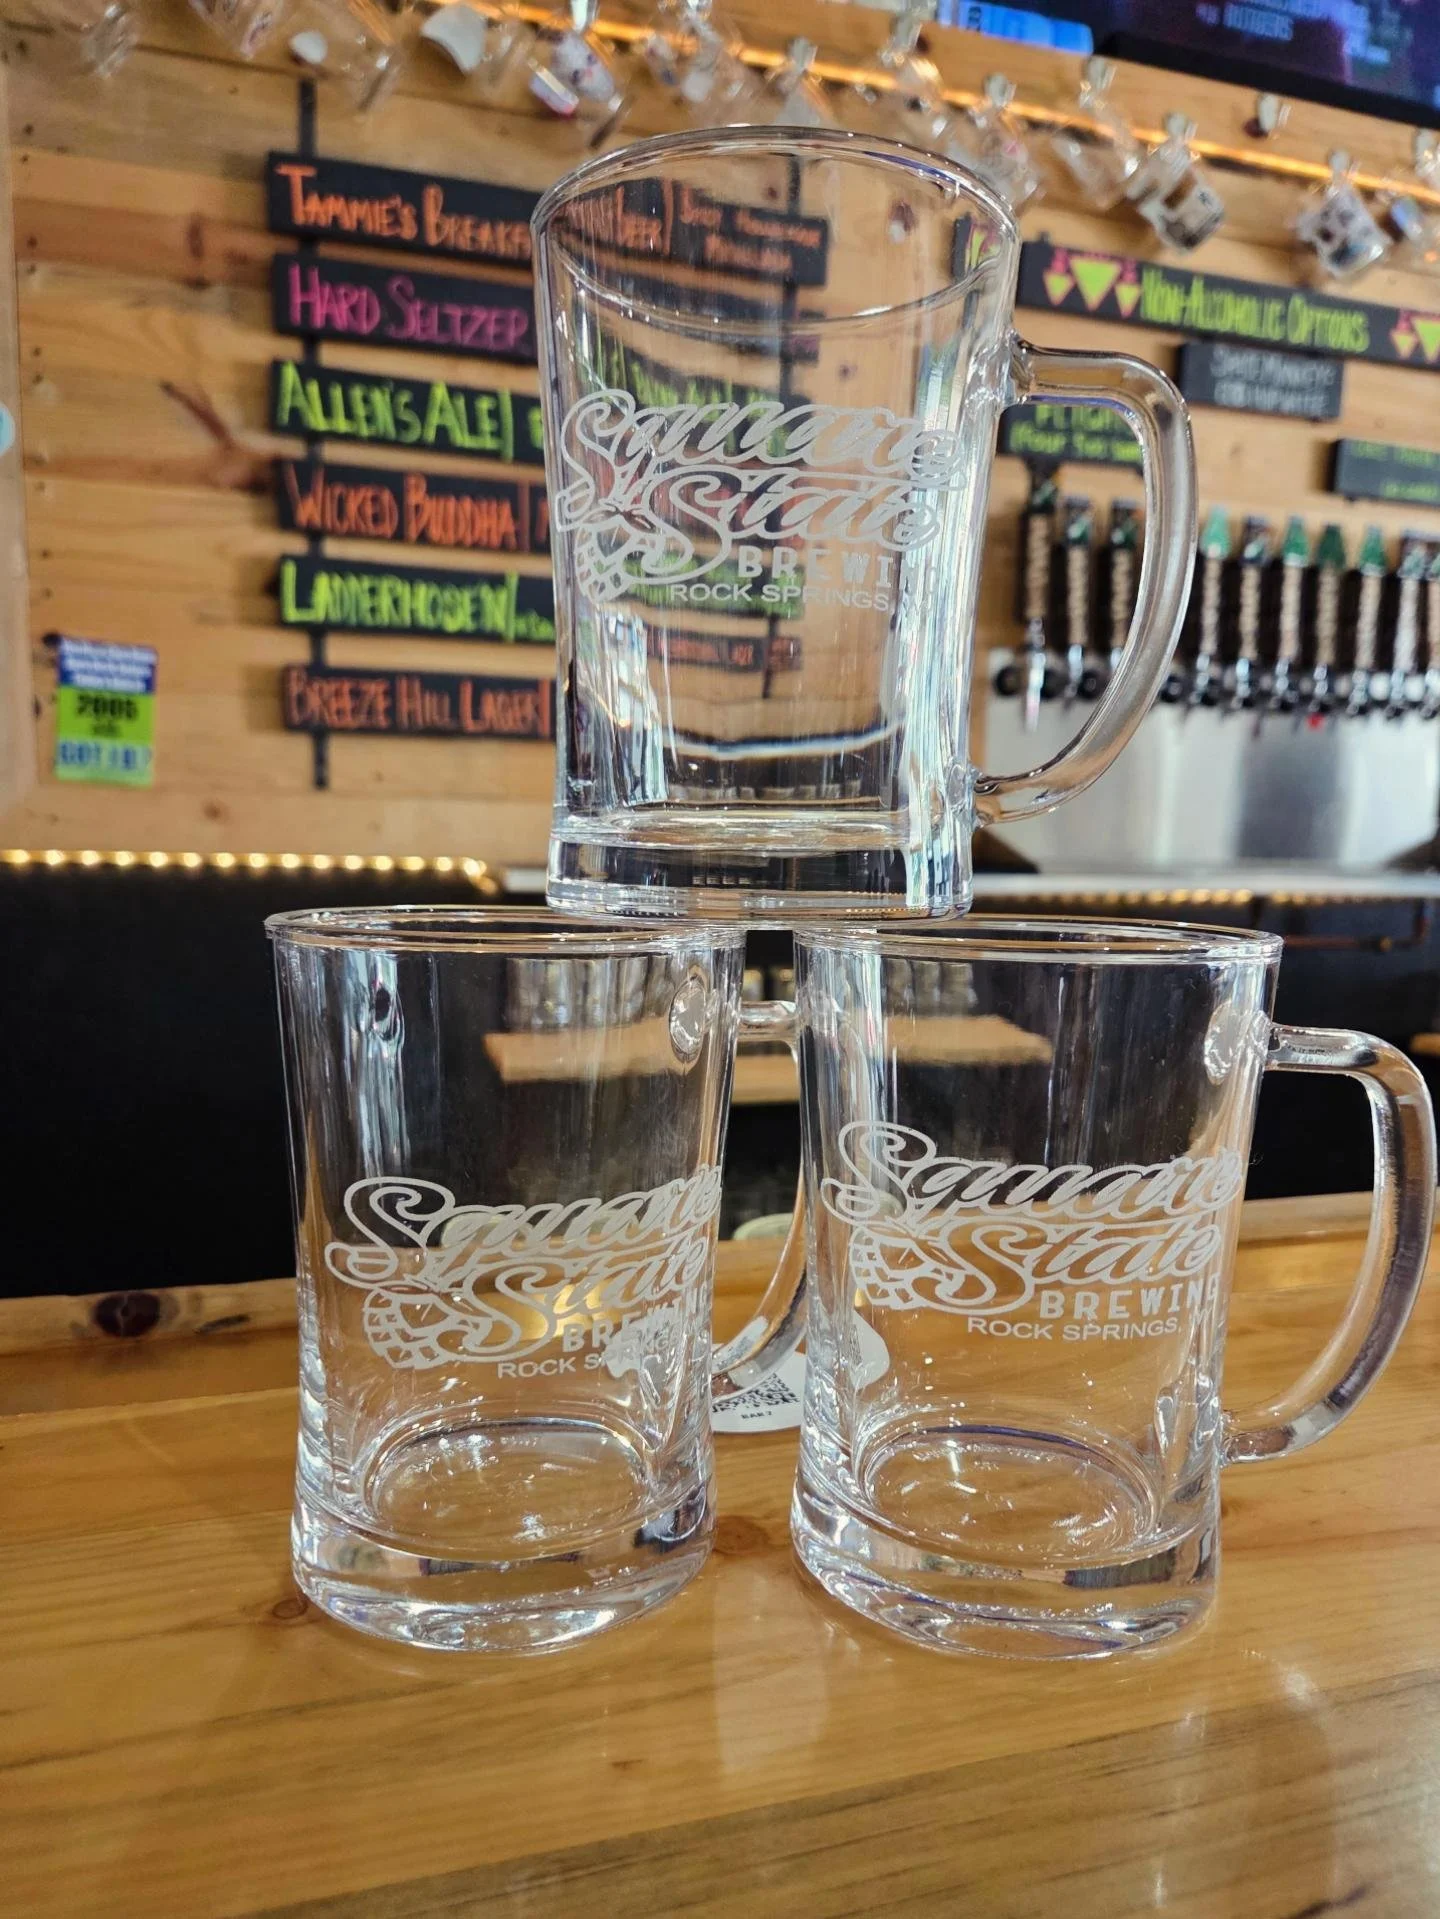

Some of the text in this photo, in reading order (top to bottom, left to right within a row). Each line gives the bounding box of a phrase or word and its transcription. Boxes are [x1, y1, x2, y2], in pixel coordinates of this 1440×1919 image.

[288, 263, 529, 350] HARD SELTZER
[276, 361, 421, 443] ALLEN'S
[628, 464, 942, 584] State
[671, 584, 753, 602] ROCK
[821, 1121, 1242, 1230] Square
[324, 1164, 721, 1288] Square
[908, 1213, 1222, 1315] State
[434, 1232, 708, 1362] State
[967, 1317, 1054, 1341] ROCK
[498, 1356, 576, 1379] ROCK
